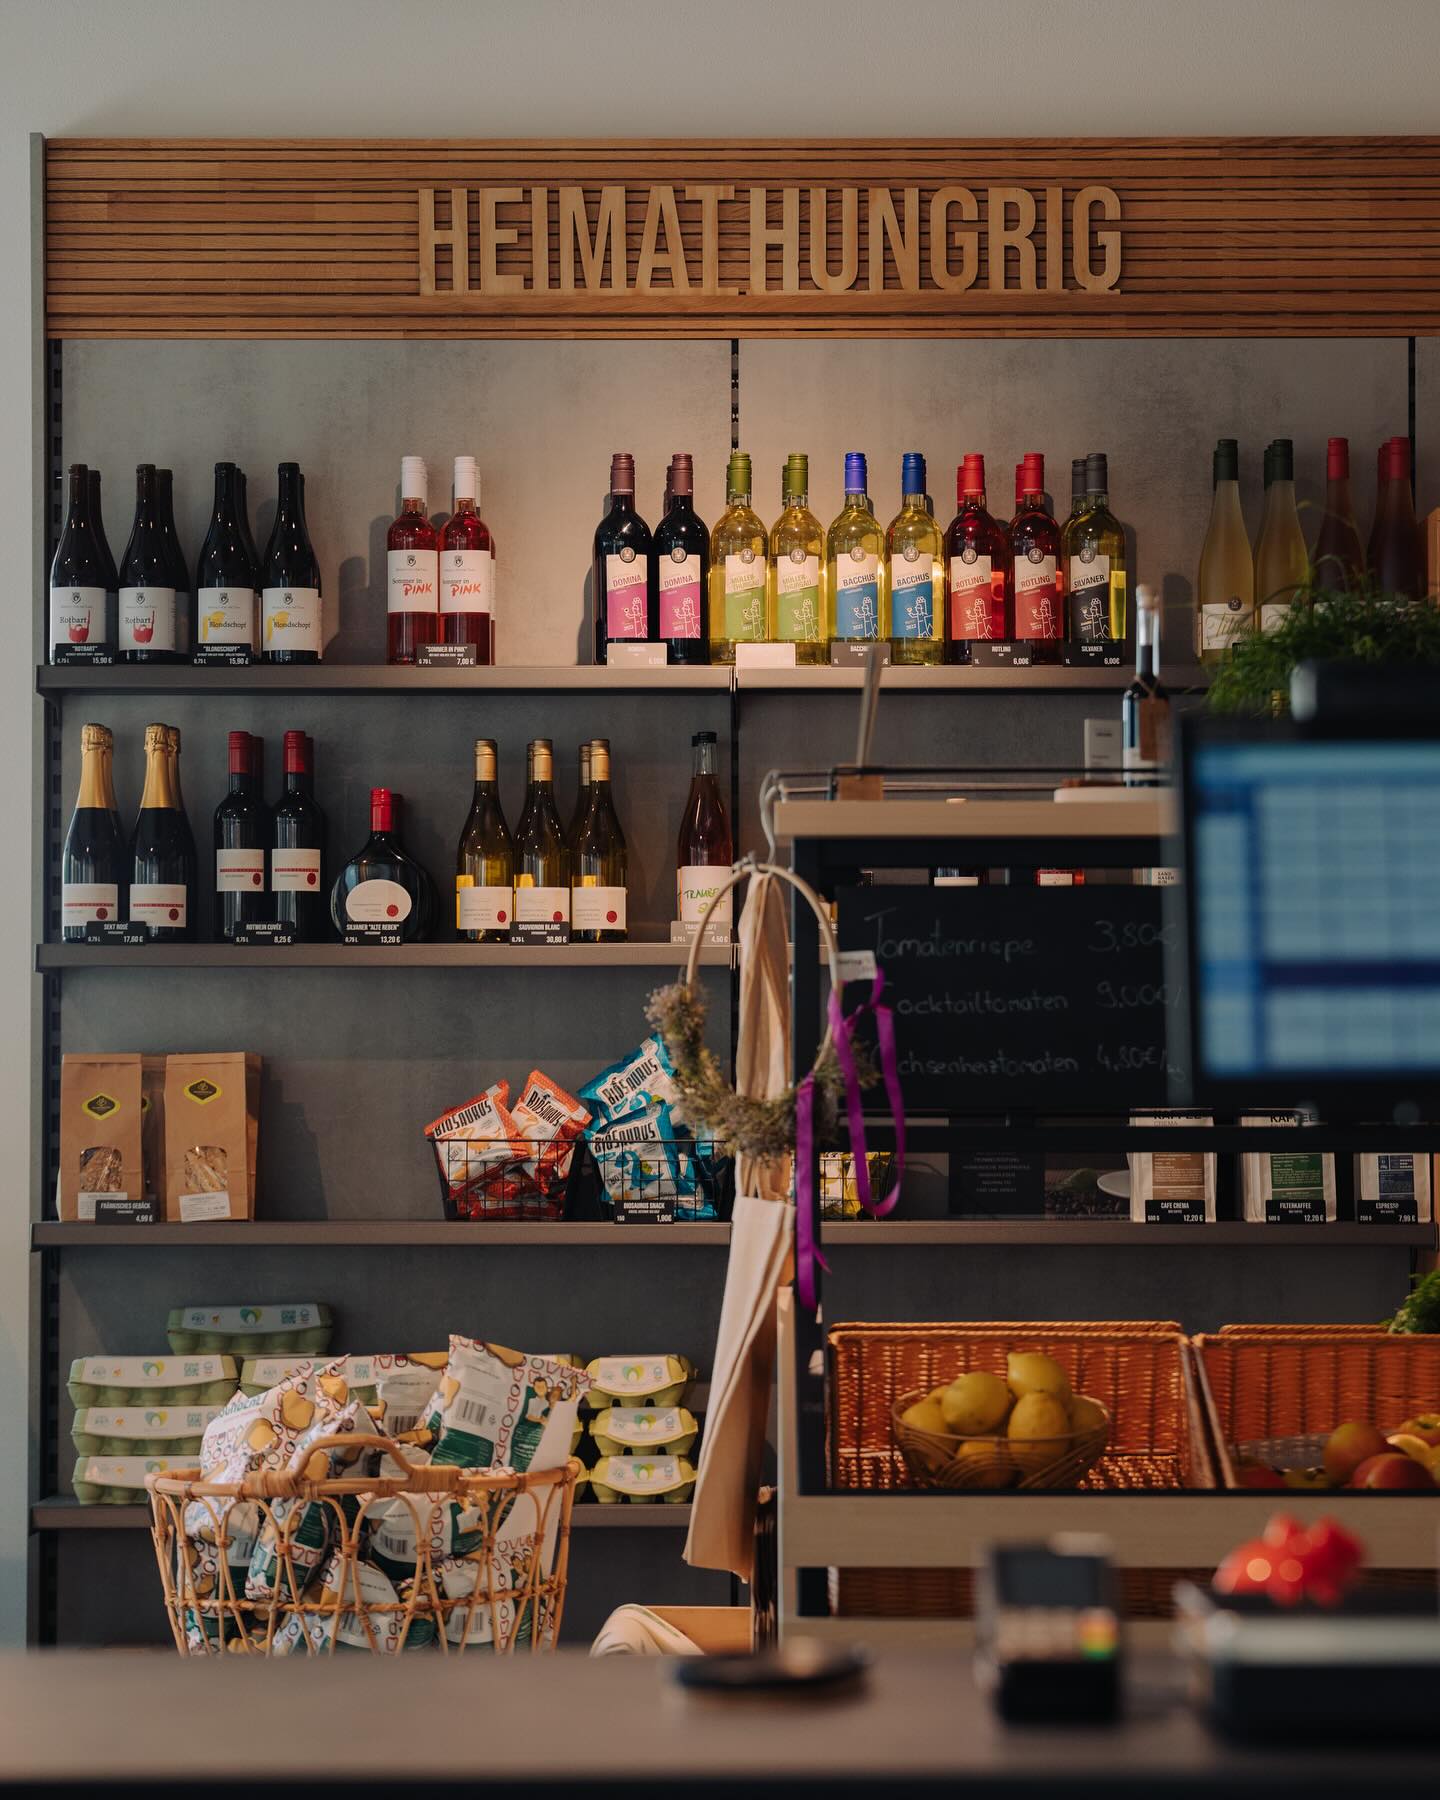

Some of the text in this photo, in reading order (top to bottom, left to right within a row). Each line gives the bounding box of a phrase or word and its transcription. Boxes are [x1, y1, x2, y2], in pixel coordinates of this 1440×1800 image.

[416, 576, 423, 584] in
[612, 575, 642, 588] DOMINA
[664, 575, 694, 588] DOMINA
[843, 573, 876, 587] BACCHUS
[896, 573, 930, 587] BACCHUS
[956, 576, 985, 589] ROTLING
[1021, 575, 1051, 588] ROTLING
[1073, 575, 1105, 588] SILVANER
[403, 583, 433, 596] PINK
[450, 583, 482, 597] PINK
[59, 616, 87, 624] Rotbart
[124, 616, 152, 624] Rotbart
[208, 620, 247, 630] Blondschopf
[272, 620, 311, 630] Blondschopf
[267, 922, 282, 930] CUVÉE
[601, 1058, 659, 1105] BIOSAURUS
[525, 1090, 567, 1128] BIOSAURUS
[433, 1099, 493, 1137] BIOSAURUS
[594, 1121, 656, 1153] BIOSAURUS
[100, 1200, 151, 1209] FRÄNKISCHES GEBÄCK
